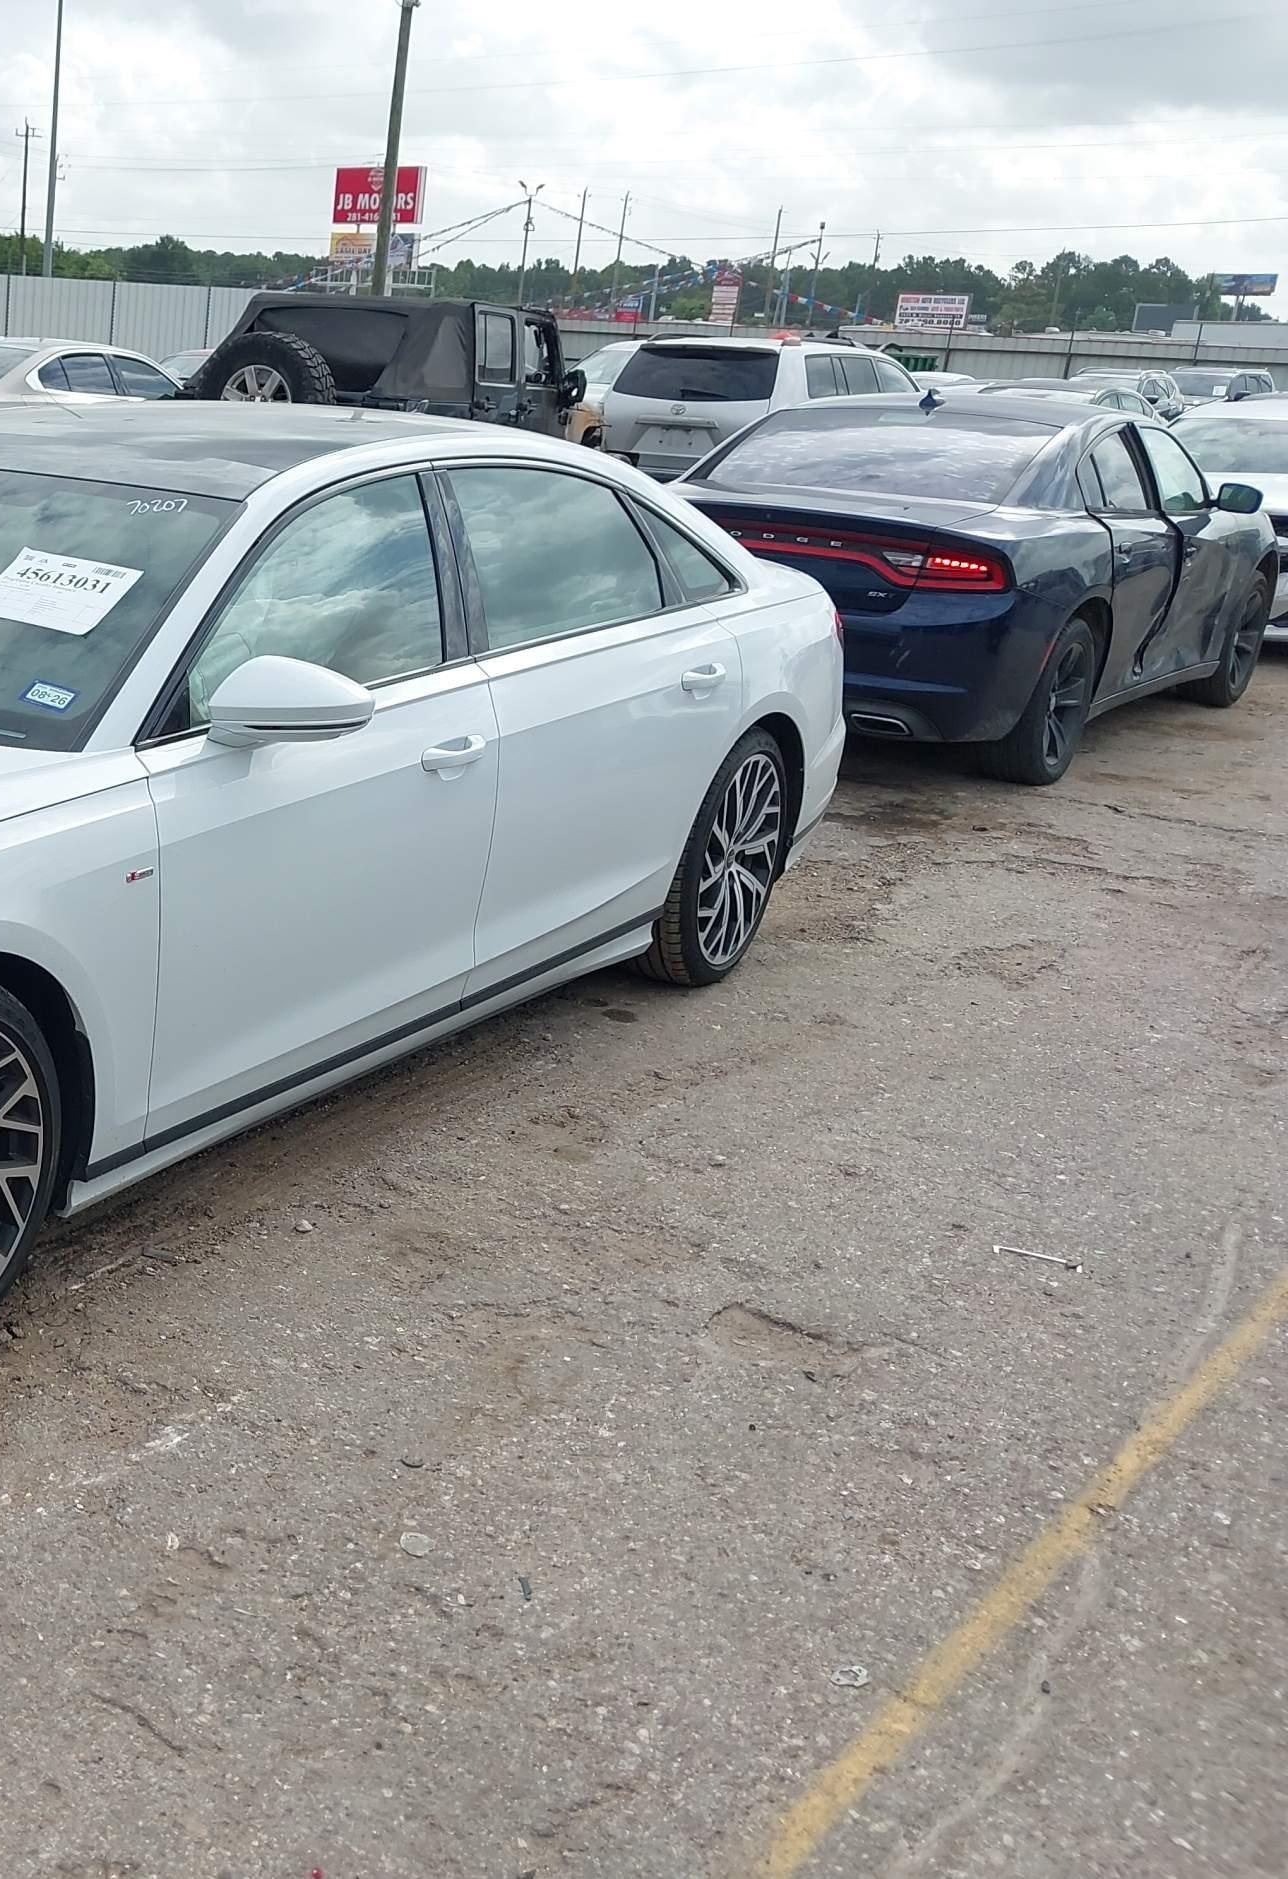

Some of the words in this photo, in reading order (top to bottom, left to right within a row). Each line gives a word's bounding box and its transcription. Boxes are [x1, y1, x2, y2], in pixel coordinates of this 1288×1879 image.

[337, 192, 353, 210] JB
[356, 192, 415, 210] MORS
[126, 498, 188, 515] 70207
[730, 529, 844, 548] ODGE
[16, 565, 112, 595] 45613031
[867, 590, 896, 599] SX
